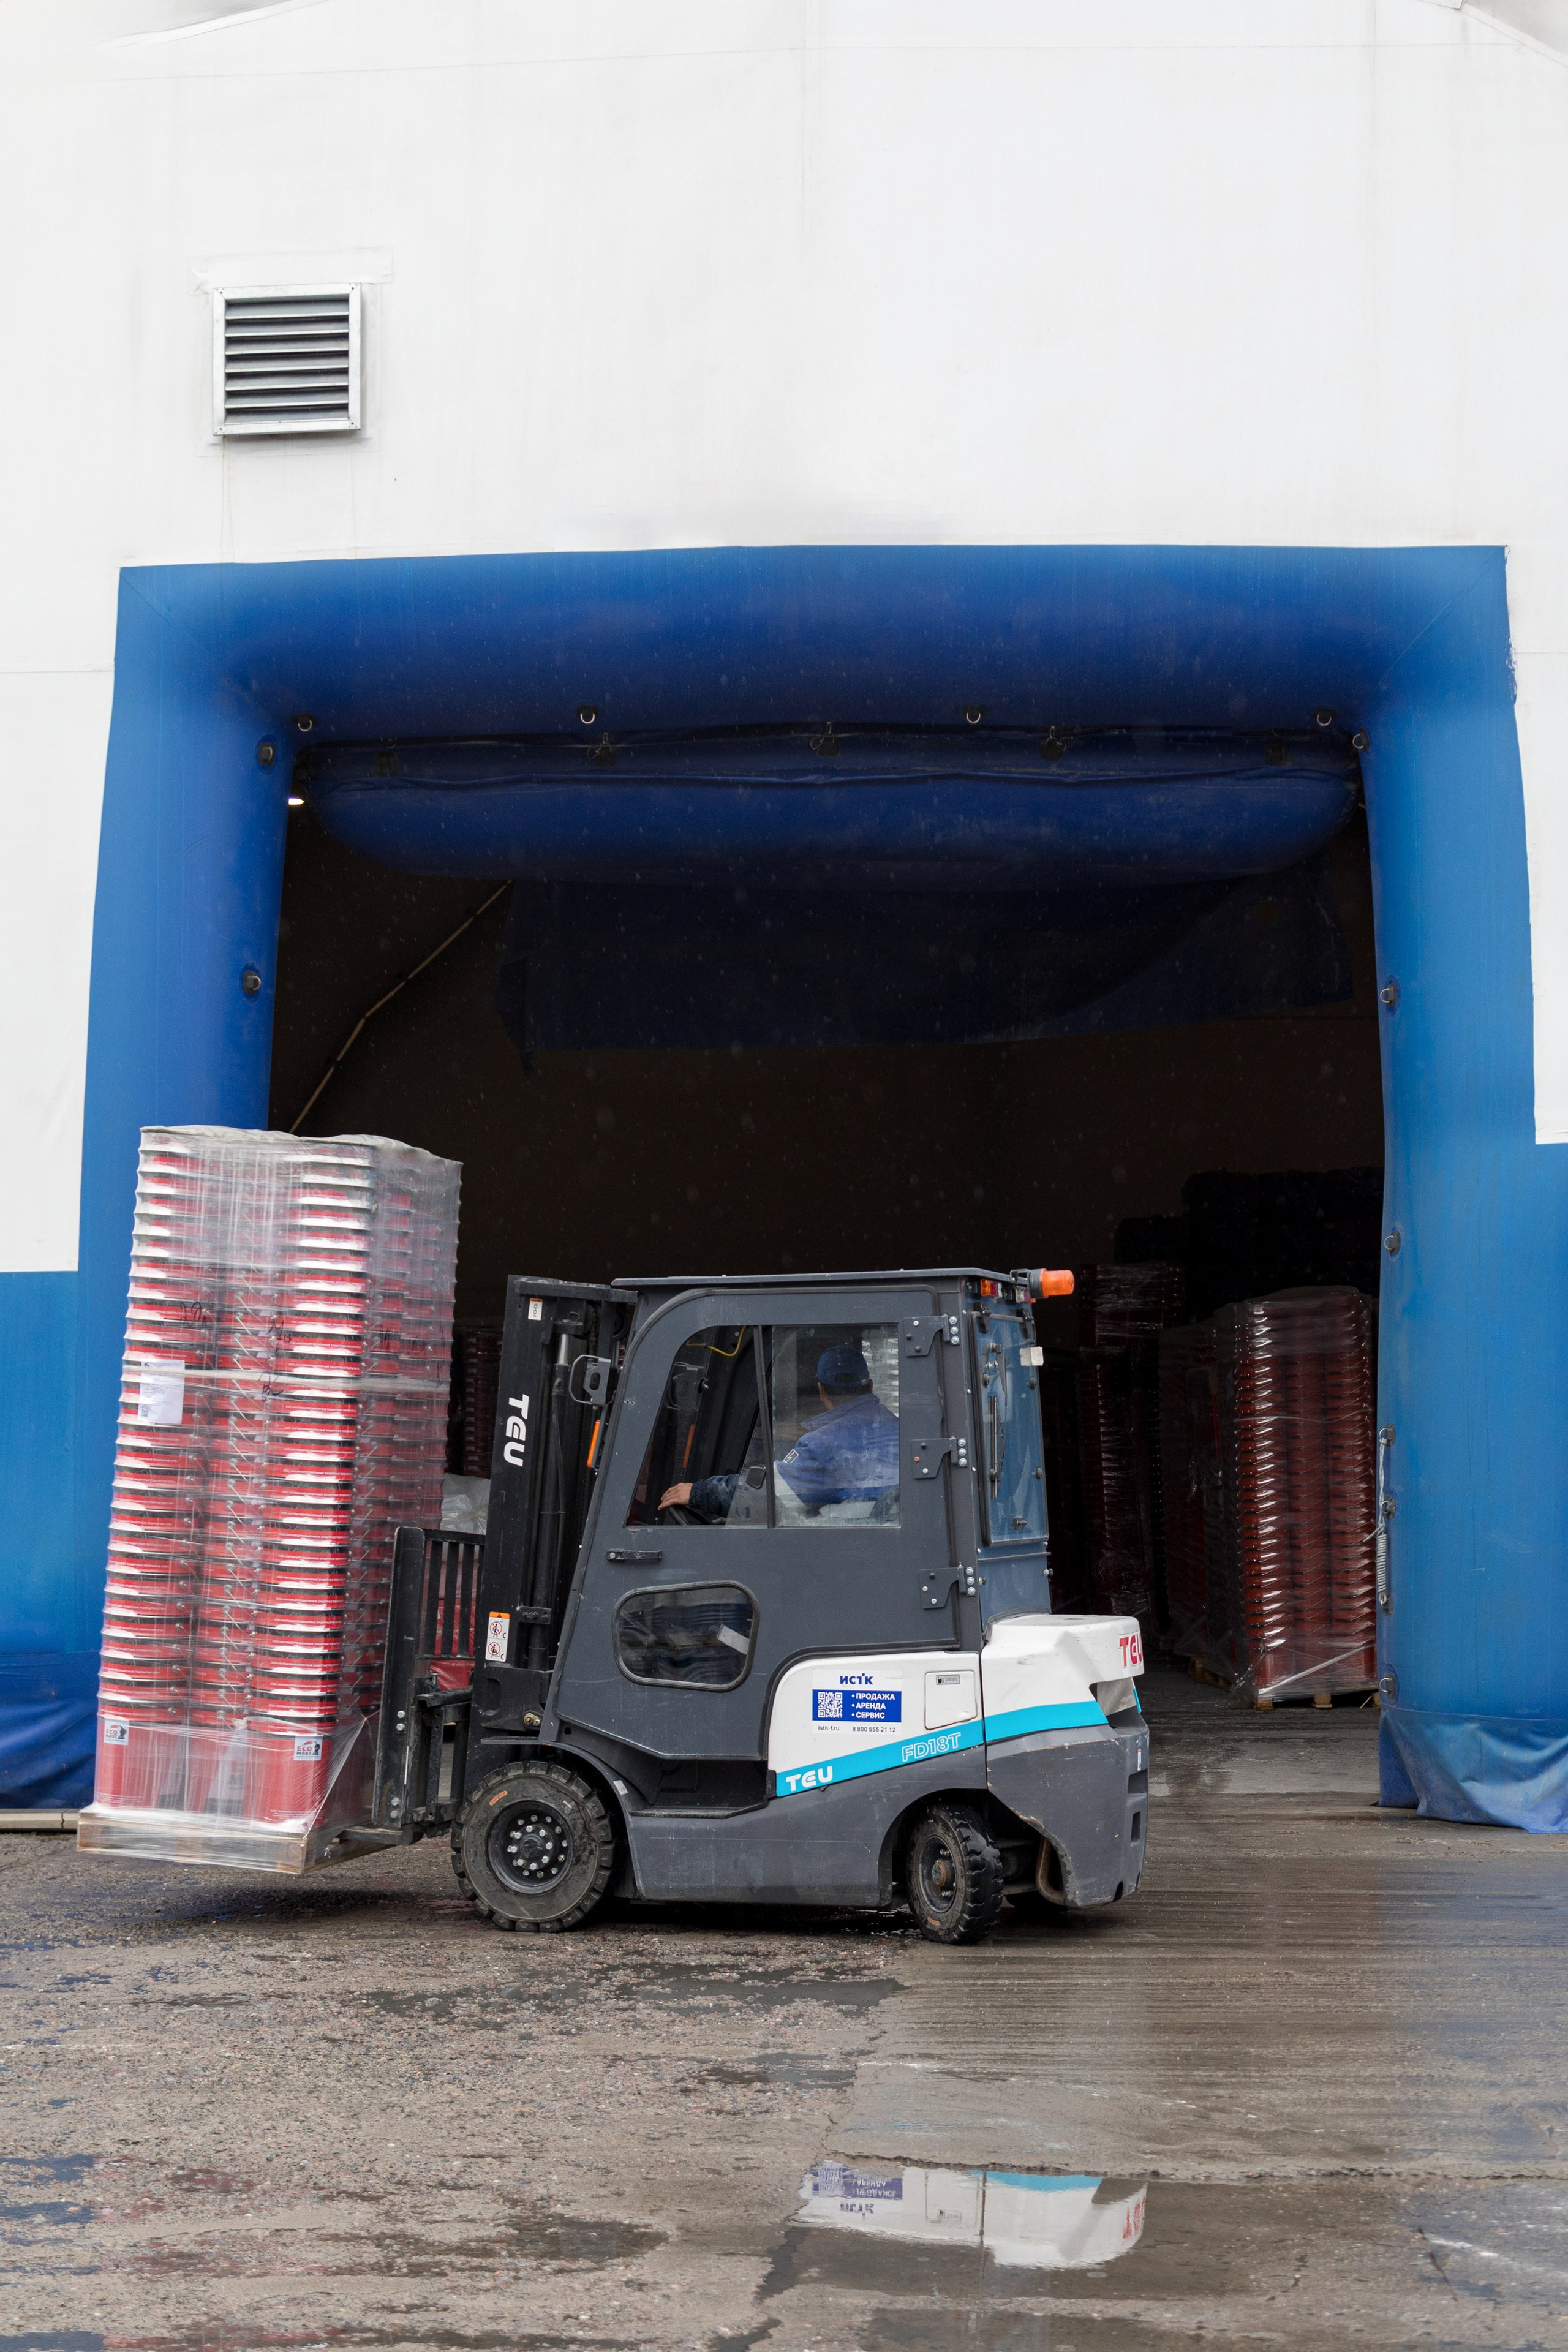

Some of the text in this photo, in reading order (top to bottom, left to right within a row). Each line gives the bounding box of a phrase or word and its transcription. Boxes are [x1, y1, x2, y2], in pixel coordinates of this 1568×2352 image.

[503, 1394, 529, 1467] TEU
[901, 1732, 962, 1762] FD18T
[785, 1766, 833, 1792] TEU
